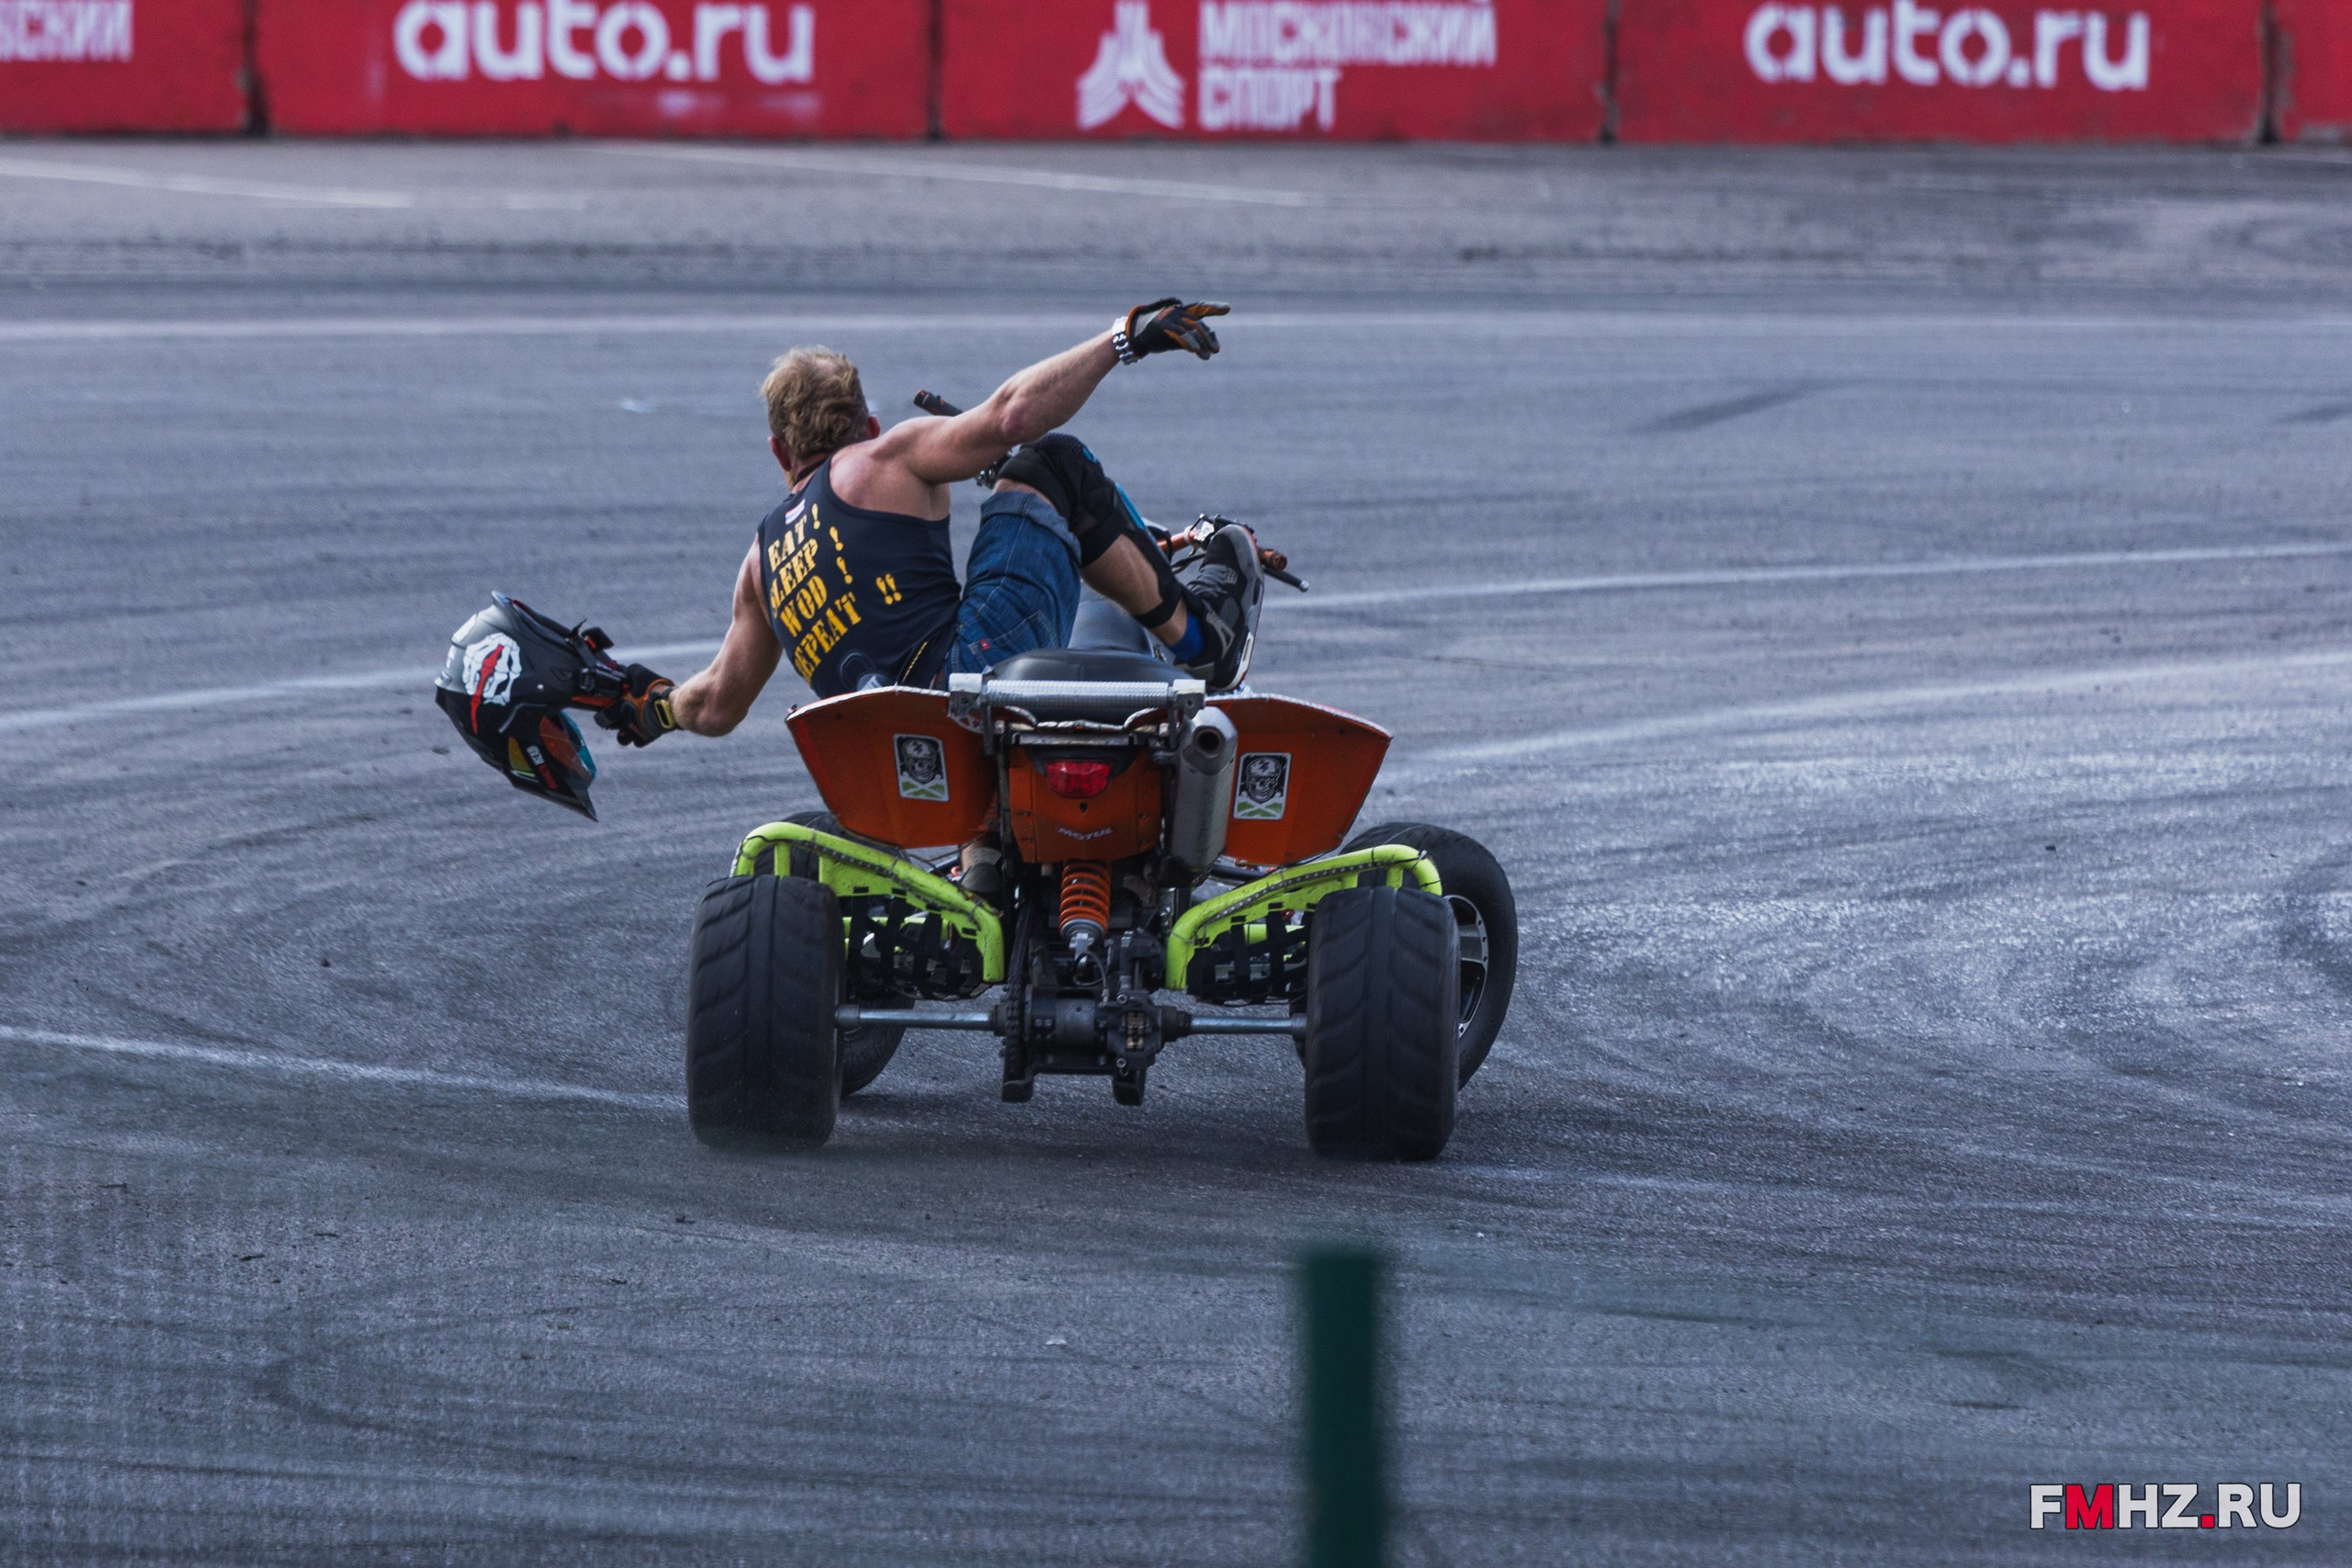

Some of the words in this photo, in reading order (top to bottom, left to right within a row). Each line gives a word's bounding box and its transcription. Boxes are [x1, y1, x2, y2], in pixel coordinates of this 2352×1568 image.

[392, 0, 816, 85] auto.ru
[1744, 0, 2151, 91] auto.ru
[767, 514, 808, 574] EAT
[780, 575, 828, 637] WOD
